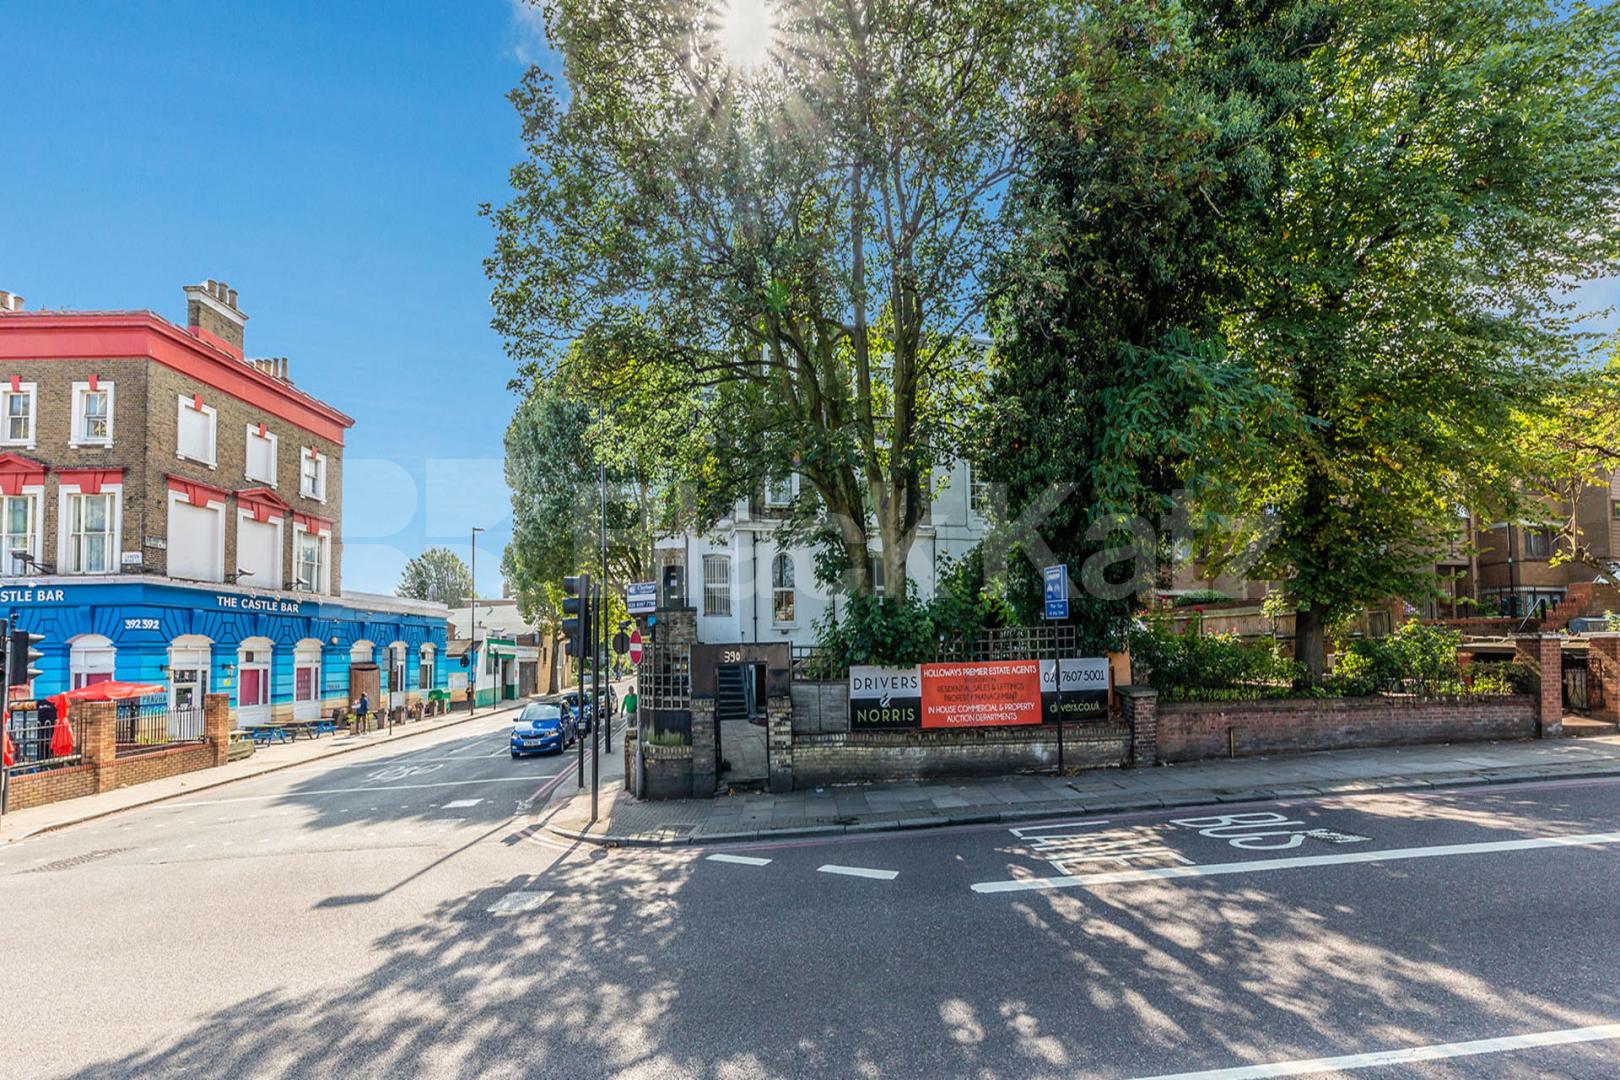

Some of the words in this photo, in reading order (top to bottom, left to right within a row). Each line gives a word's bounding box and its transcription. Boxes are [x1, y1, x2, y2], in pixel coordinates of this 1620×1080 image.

[0, 590, 32, 602] STLE
[37, 590, 64, 601] BAR
[216, 596, 237, 608] THE
[241, 598, 278, 611] CASTLE
[280, 602, 299, 613] BAR
[125, 619, 142, 629] 392
[143, 619, 160, 629] 392
[724, 650, 741, 663] 390
[962, 666, 989, 676] PREMIER
[989, 665, 1011, 675] ESTATE
[1011, 664, 1037, 674] AGENTS
[1043, 671, 1057, 683] 02
[1062, 670, 1083, 682] 7607
[1083, 669, 1105, 681] 5001
[853, 675, 918, 690] DRIVERS
[879, 689, 891, 708] &
[928, 706, 935, 714] IN
[936, 704, 957, 714] HOUSE
[999, 703, 1004, 711] &
[1005, 701, 1035, 711] PROPERTY
[857, 707, 915, 723] NORRIS
[946, 713, 975, 723] AUCTION
[975, 712, 1018, 721] DEPARTMENTS
[1169, 812, 1305, 850] BUS
